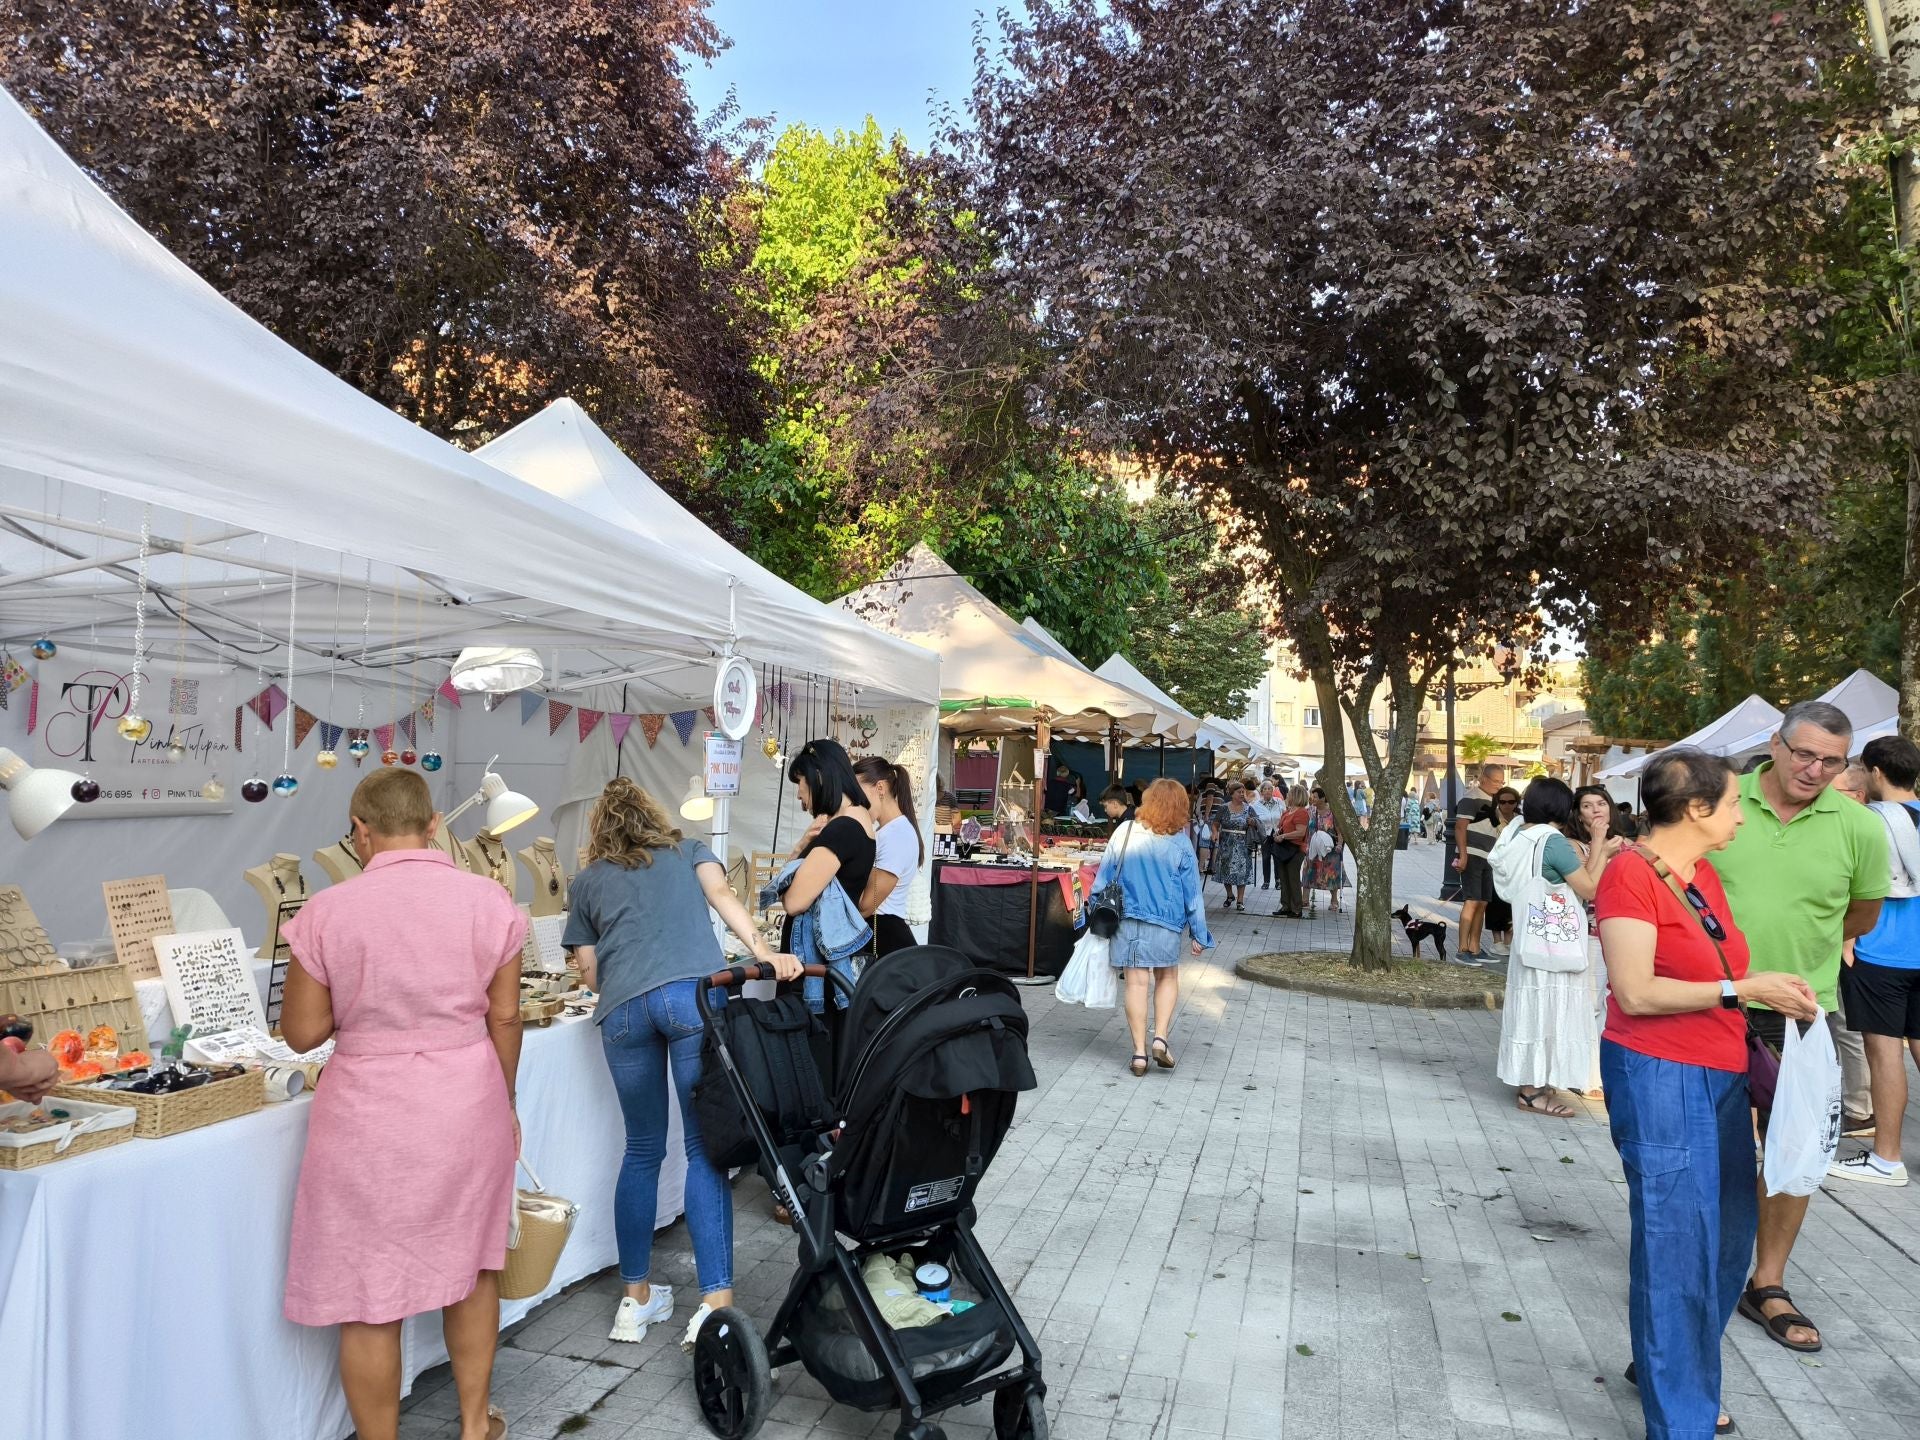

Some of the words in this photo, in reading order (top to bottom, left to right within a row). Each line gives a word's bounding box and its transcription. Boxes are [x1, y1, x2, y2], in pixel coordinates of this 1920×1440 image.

[130, 719, 173, 764] Pink
[98, 790, 113, 799] 06
[114, 790, 133, 799] 695
[188, 789, 203, 798] TUL
